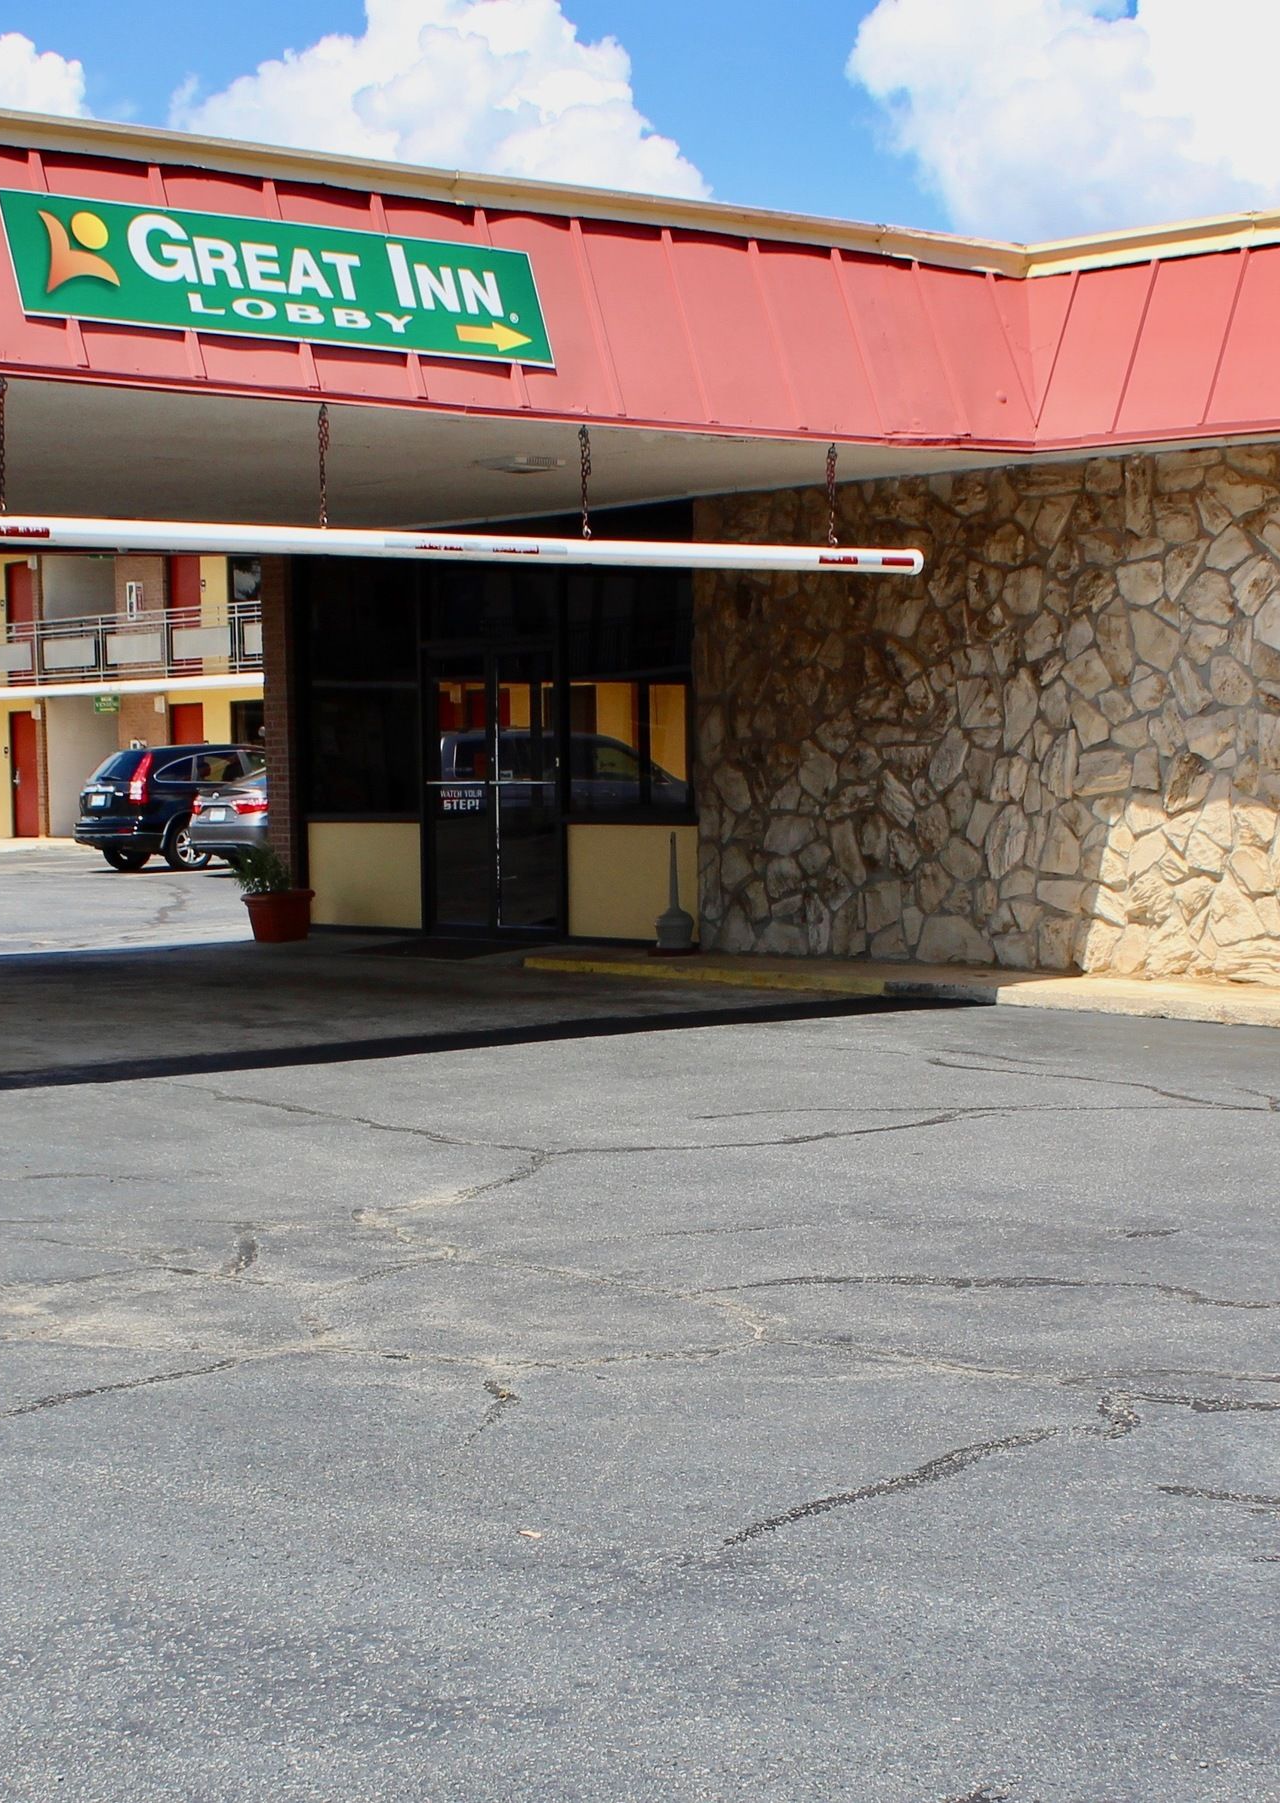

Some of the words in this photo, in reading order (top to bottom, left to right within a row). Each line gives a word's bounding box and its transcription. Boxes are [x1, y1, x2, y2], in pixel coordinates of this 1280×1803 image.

[126, 213, 360, 301] GREAT
[386, 243, 504, 318] INN
[188, 292, 414, 334] LOBBY
[440, 789, 462, 798] WATCH
[464, 789, 482, 798] YOUR
[443, 799, 480, 811] STEP!
